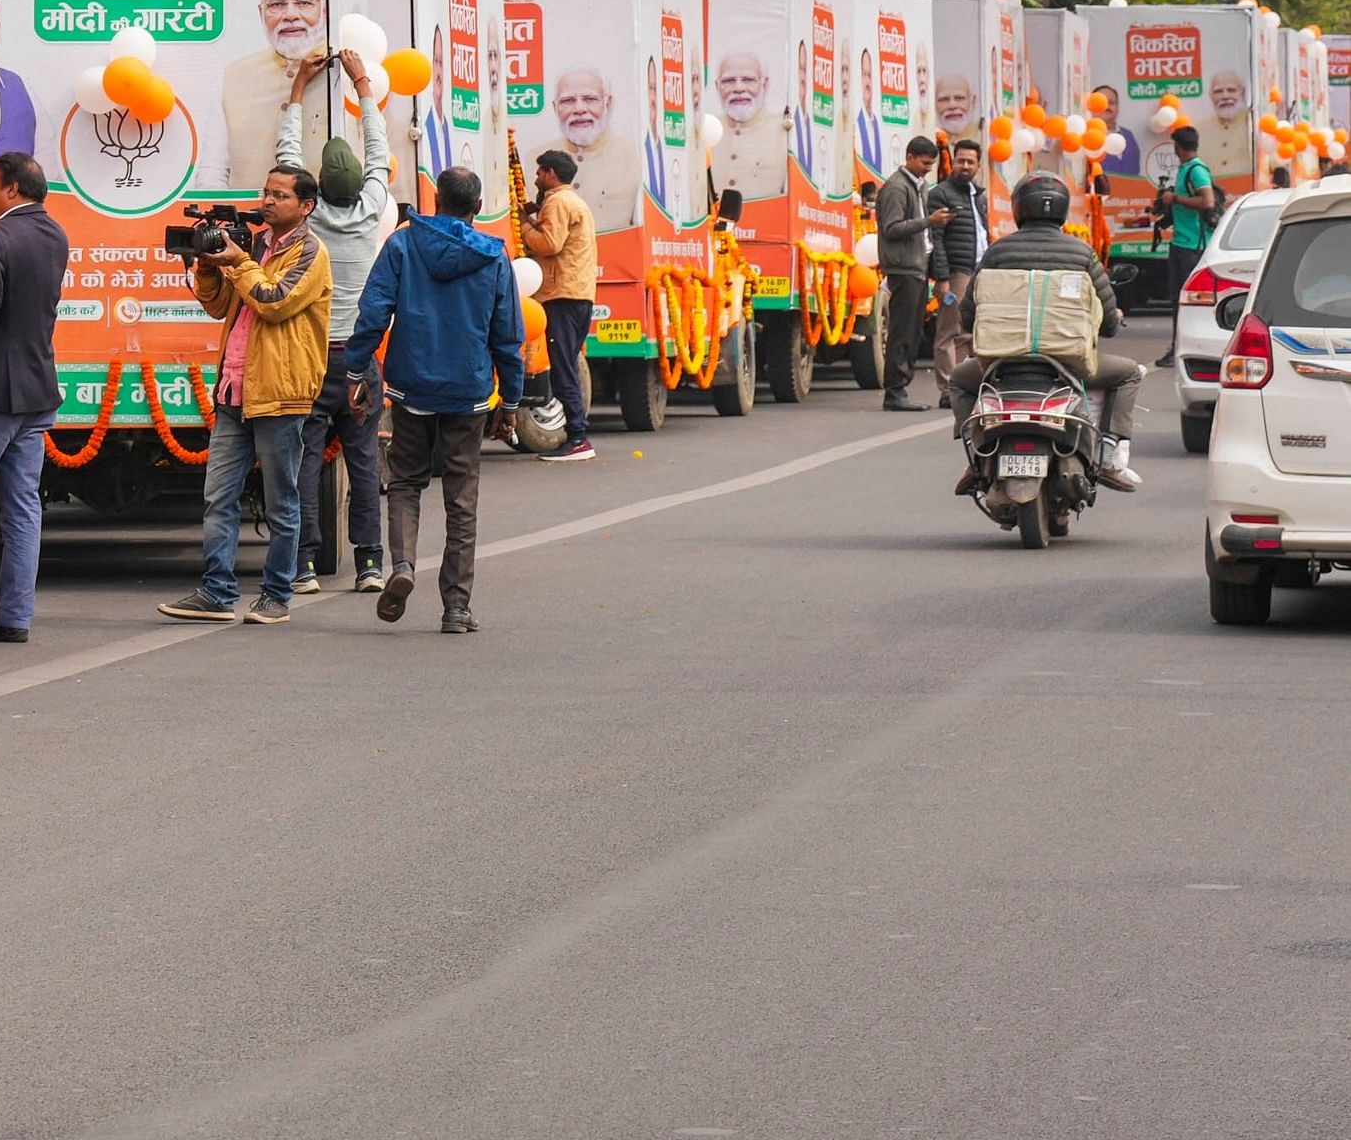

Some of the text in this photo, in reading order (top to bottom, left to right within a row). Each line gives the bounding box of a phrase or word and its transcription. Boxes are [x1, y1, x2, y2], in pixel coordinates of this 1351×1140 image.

[42, 1, 215, 33] मोदी गारंटी
[1130, 33, 1196, 53] विकसित
[1134, 56, 1194, 76] भारत
[89, 243, 149, 263] संकल्प
[81, 270, 105, 288] को
[111, 269, 145, 288] भेजें
